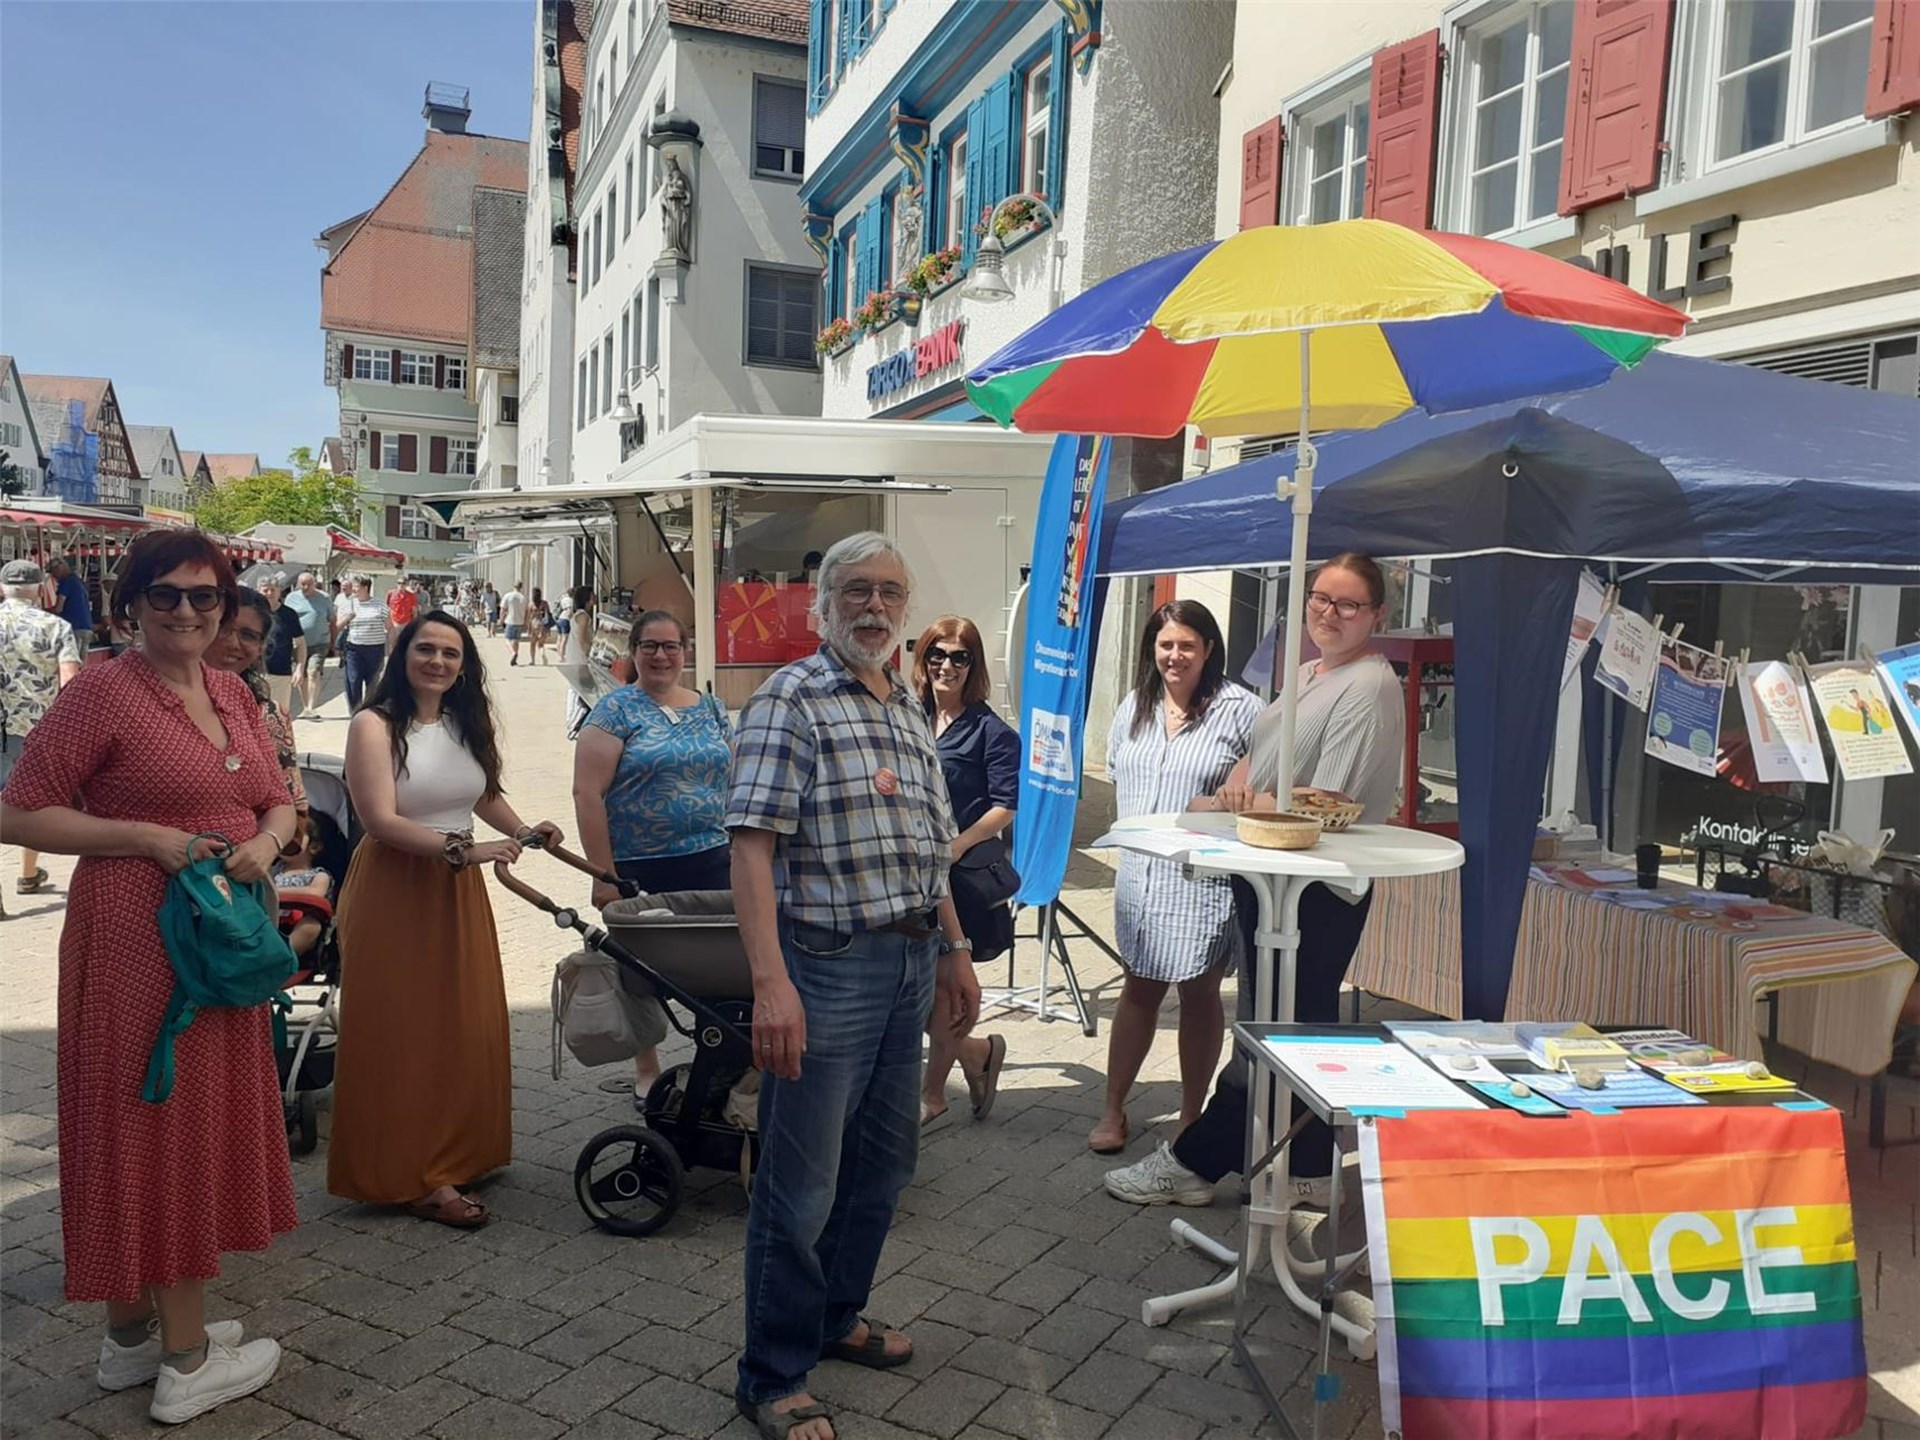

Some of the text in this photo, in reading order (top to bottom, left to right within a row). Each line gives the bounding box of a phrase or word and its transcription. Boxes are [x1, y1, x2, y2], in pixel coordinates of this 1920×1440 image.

[1157, 1176, 1174, 1191] N
[1297, 1182, 1313, 1196] N
[1469, 1206, 1817, 1326] PACE
